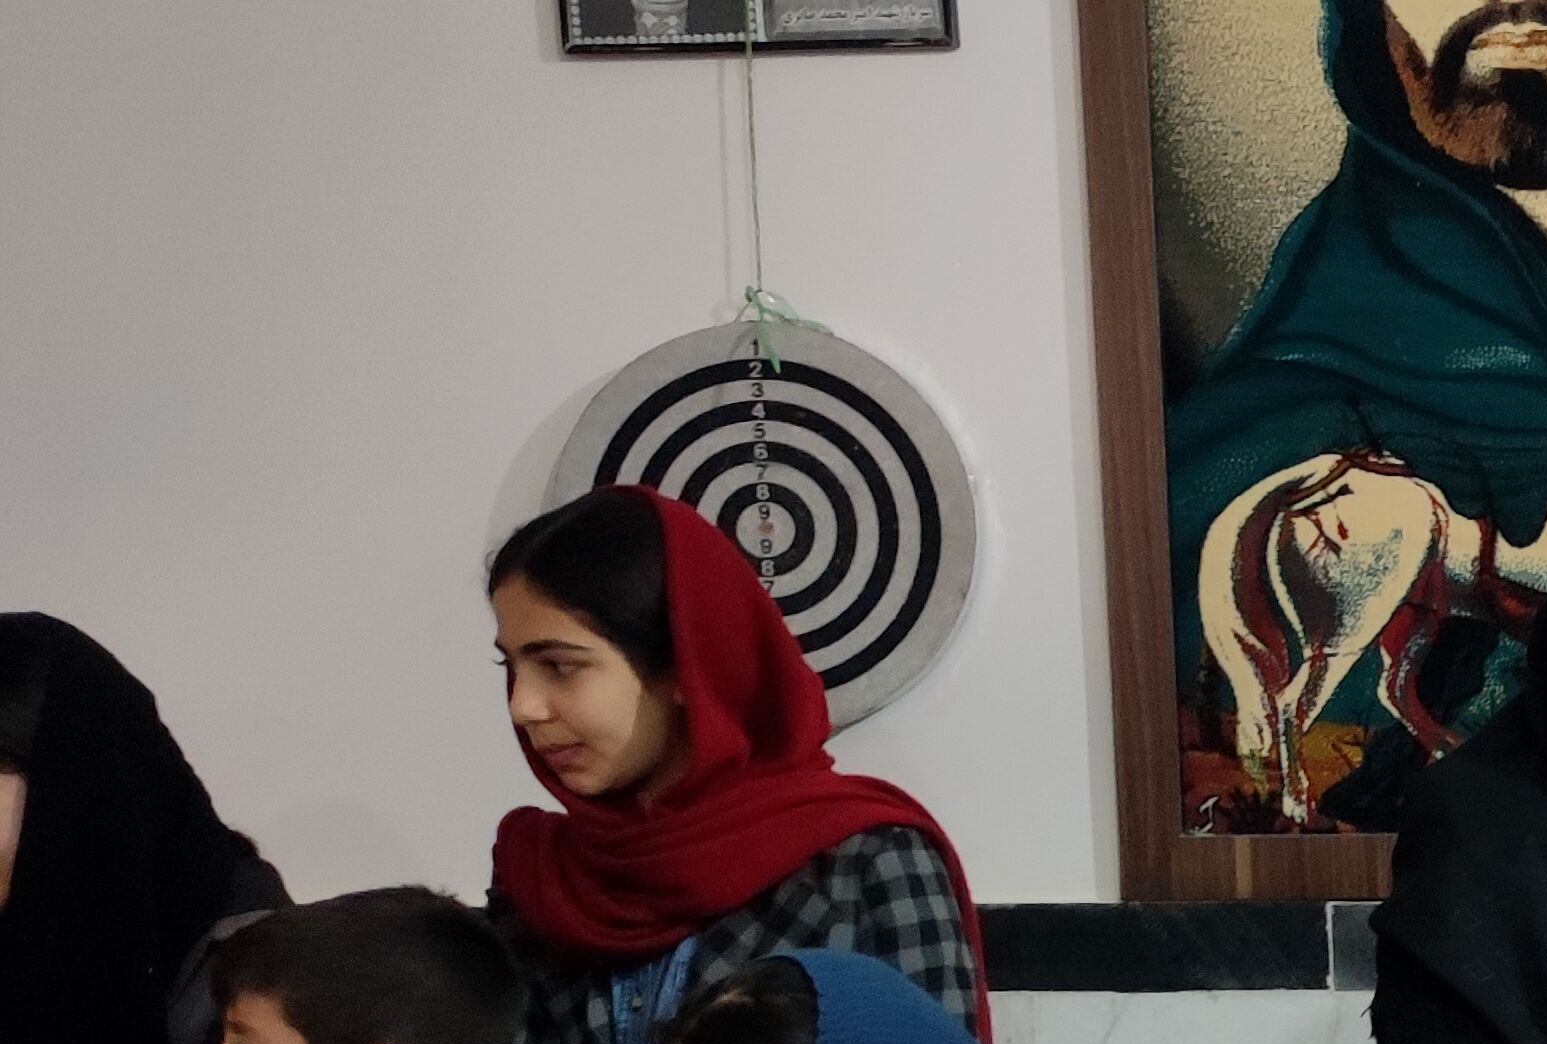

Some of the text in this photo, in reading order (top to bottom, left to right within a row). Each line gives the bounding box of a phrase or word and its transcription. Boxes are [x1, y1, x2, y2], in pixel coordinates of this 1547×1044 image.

[750, 338, 760, 356] 1
[749, 361, 763, 378] 2
[751, 382, 765, 398] 3
[751, 402, 767, 419] 4
[753, 423, 766, 439] 5
[753, 443, 768, 459] 6
[756, 463, 769, 480] 7
[756, 484, 771, 500] 8
[758, 504, 770, 520] 9
